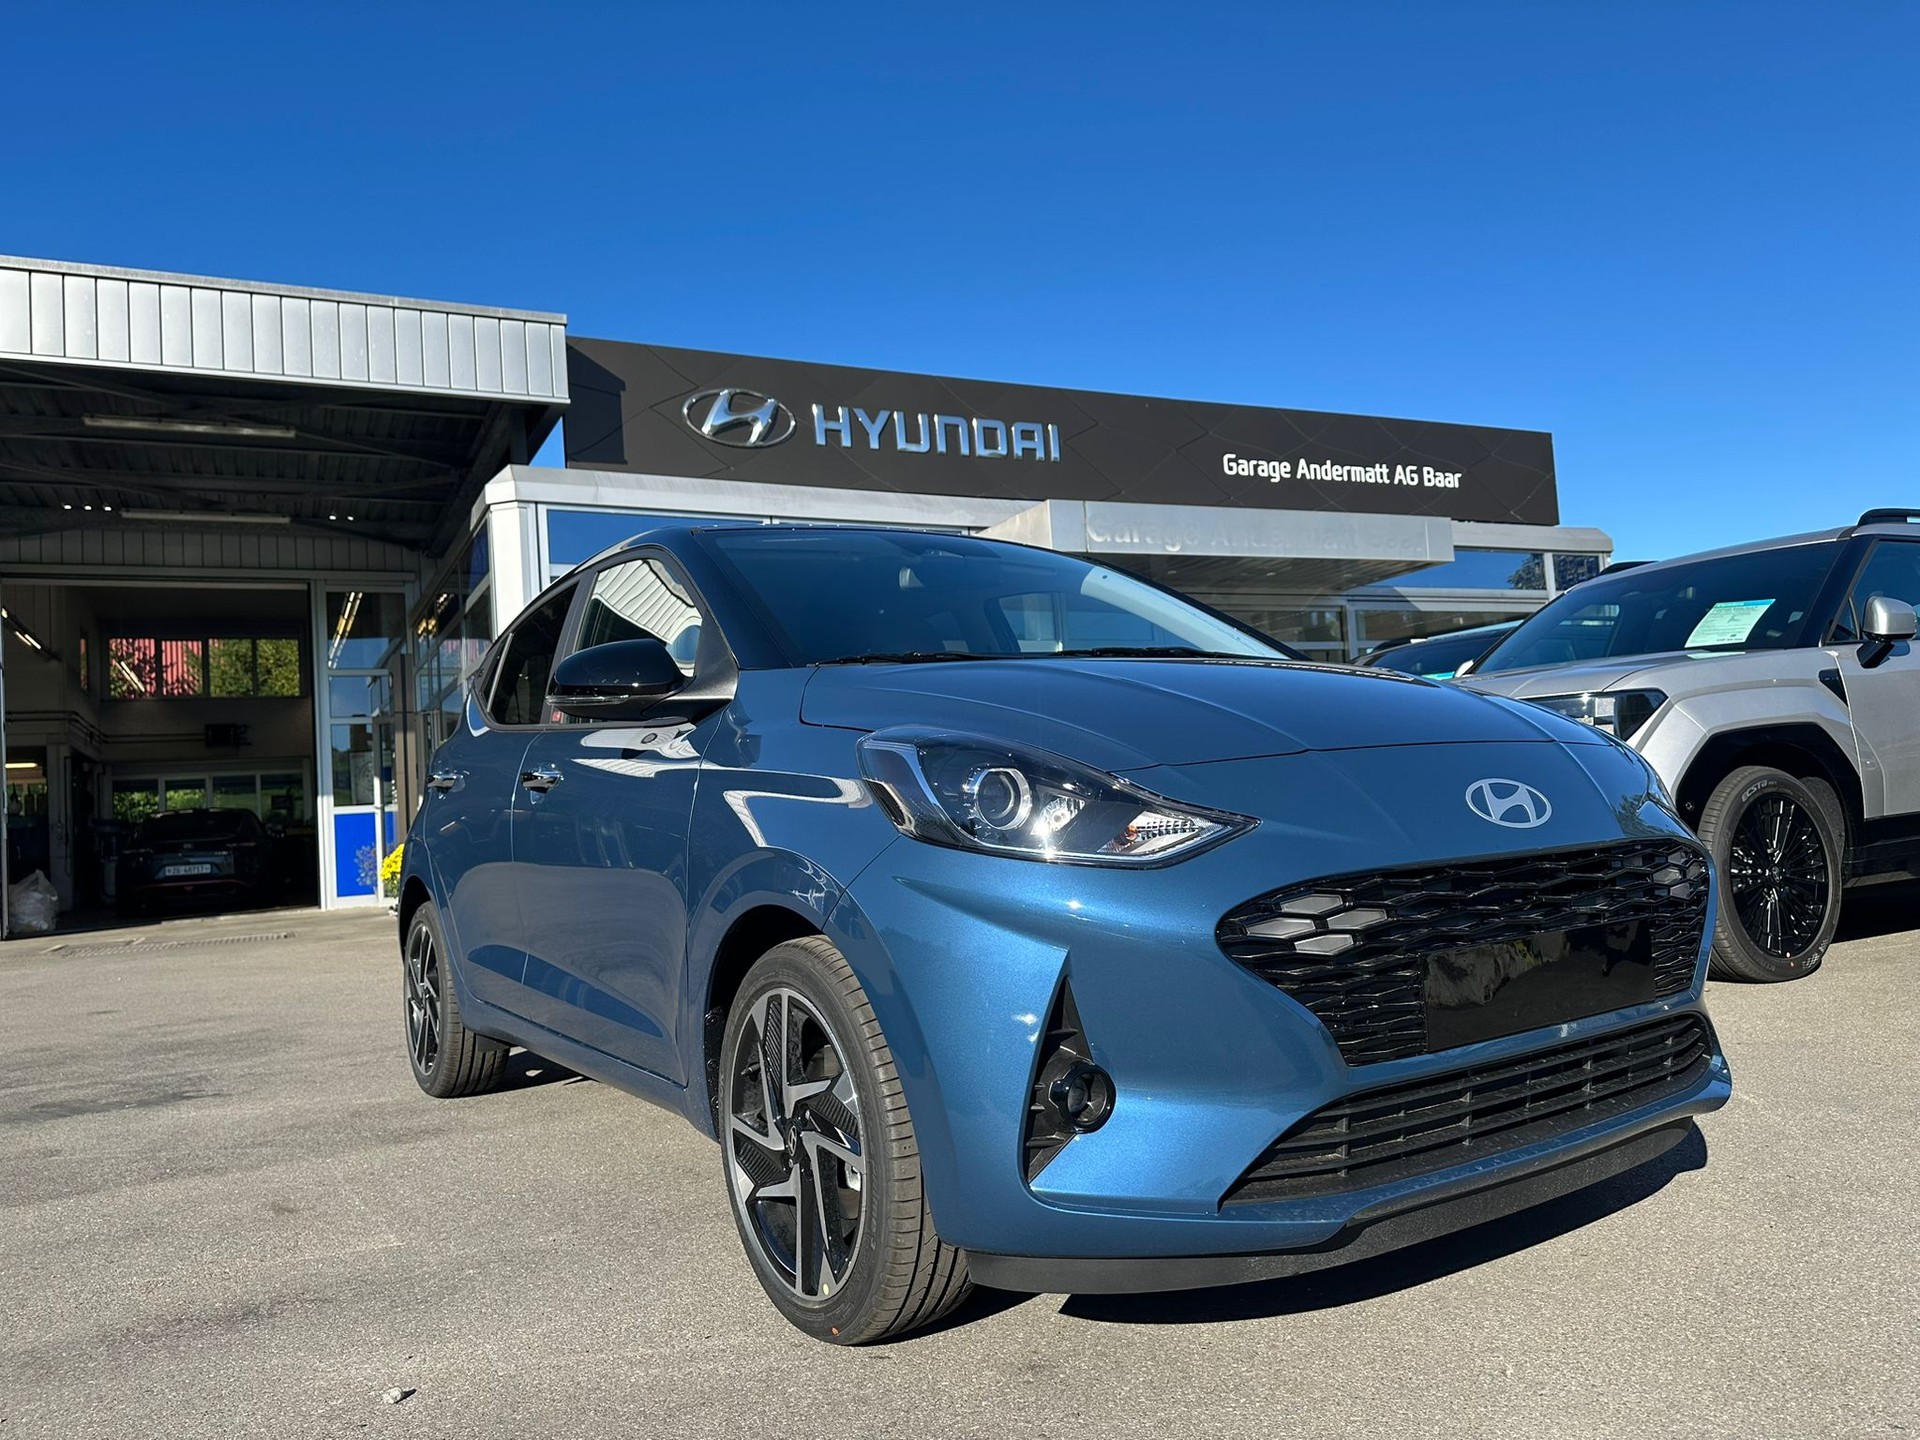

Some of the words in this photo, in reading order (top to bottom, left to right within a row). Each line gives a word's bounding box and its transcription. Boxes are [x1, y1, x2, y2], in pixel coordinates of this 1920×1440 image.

[812, 403, 1060, 462] HYUNDAI
[1222, 453, 1292, 483] Garage
[1296, 458, 1391, 484] Andermatt
[1393, 464, 1419, 486] AG
[1422, 466, 1463, 488] Baar
